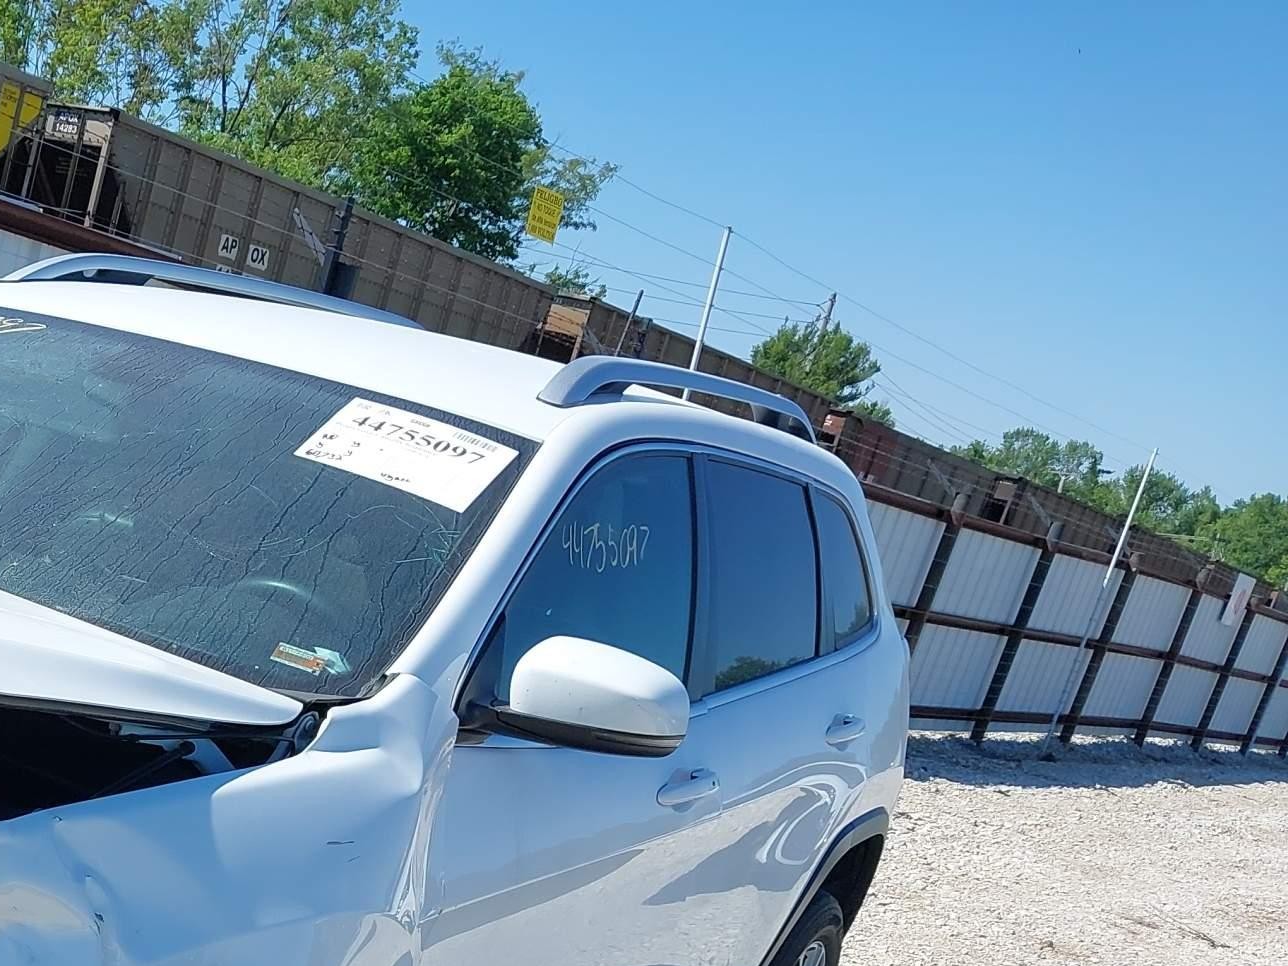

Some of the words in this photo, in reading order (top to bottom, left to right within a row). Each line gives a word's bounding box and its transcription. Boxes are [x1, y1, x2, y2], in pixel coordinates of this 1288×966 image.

[536, 188, 563, 207] PELIGRO
[220, 237, 238, 254] AP
[250, 247, 268, 266] OX
[352, 416, 486, 464] 44755097
[561, 520, 650, 573] 44755097
